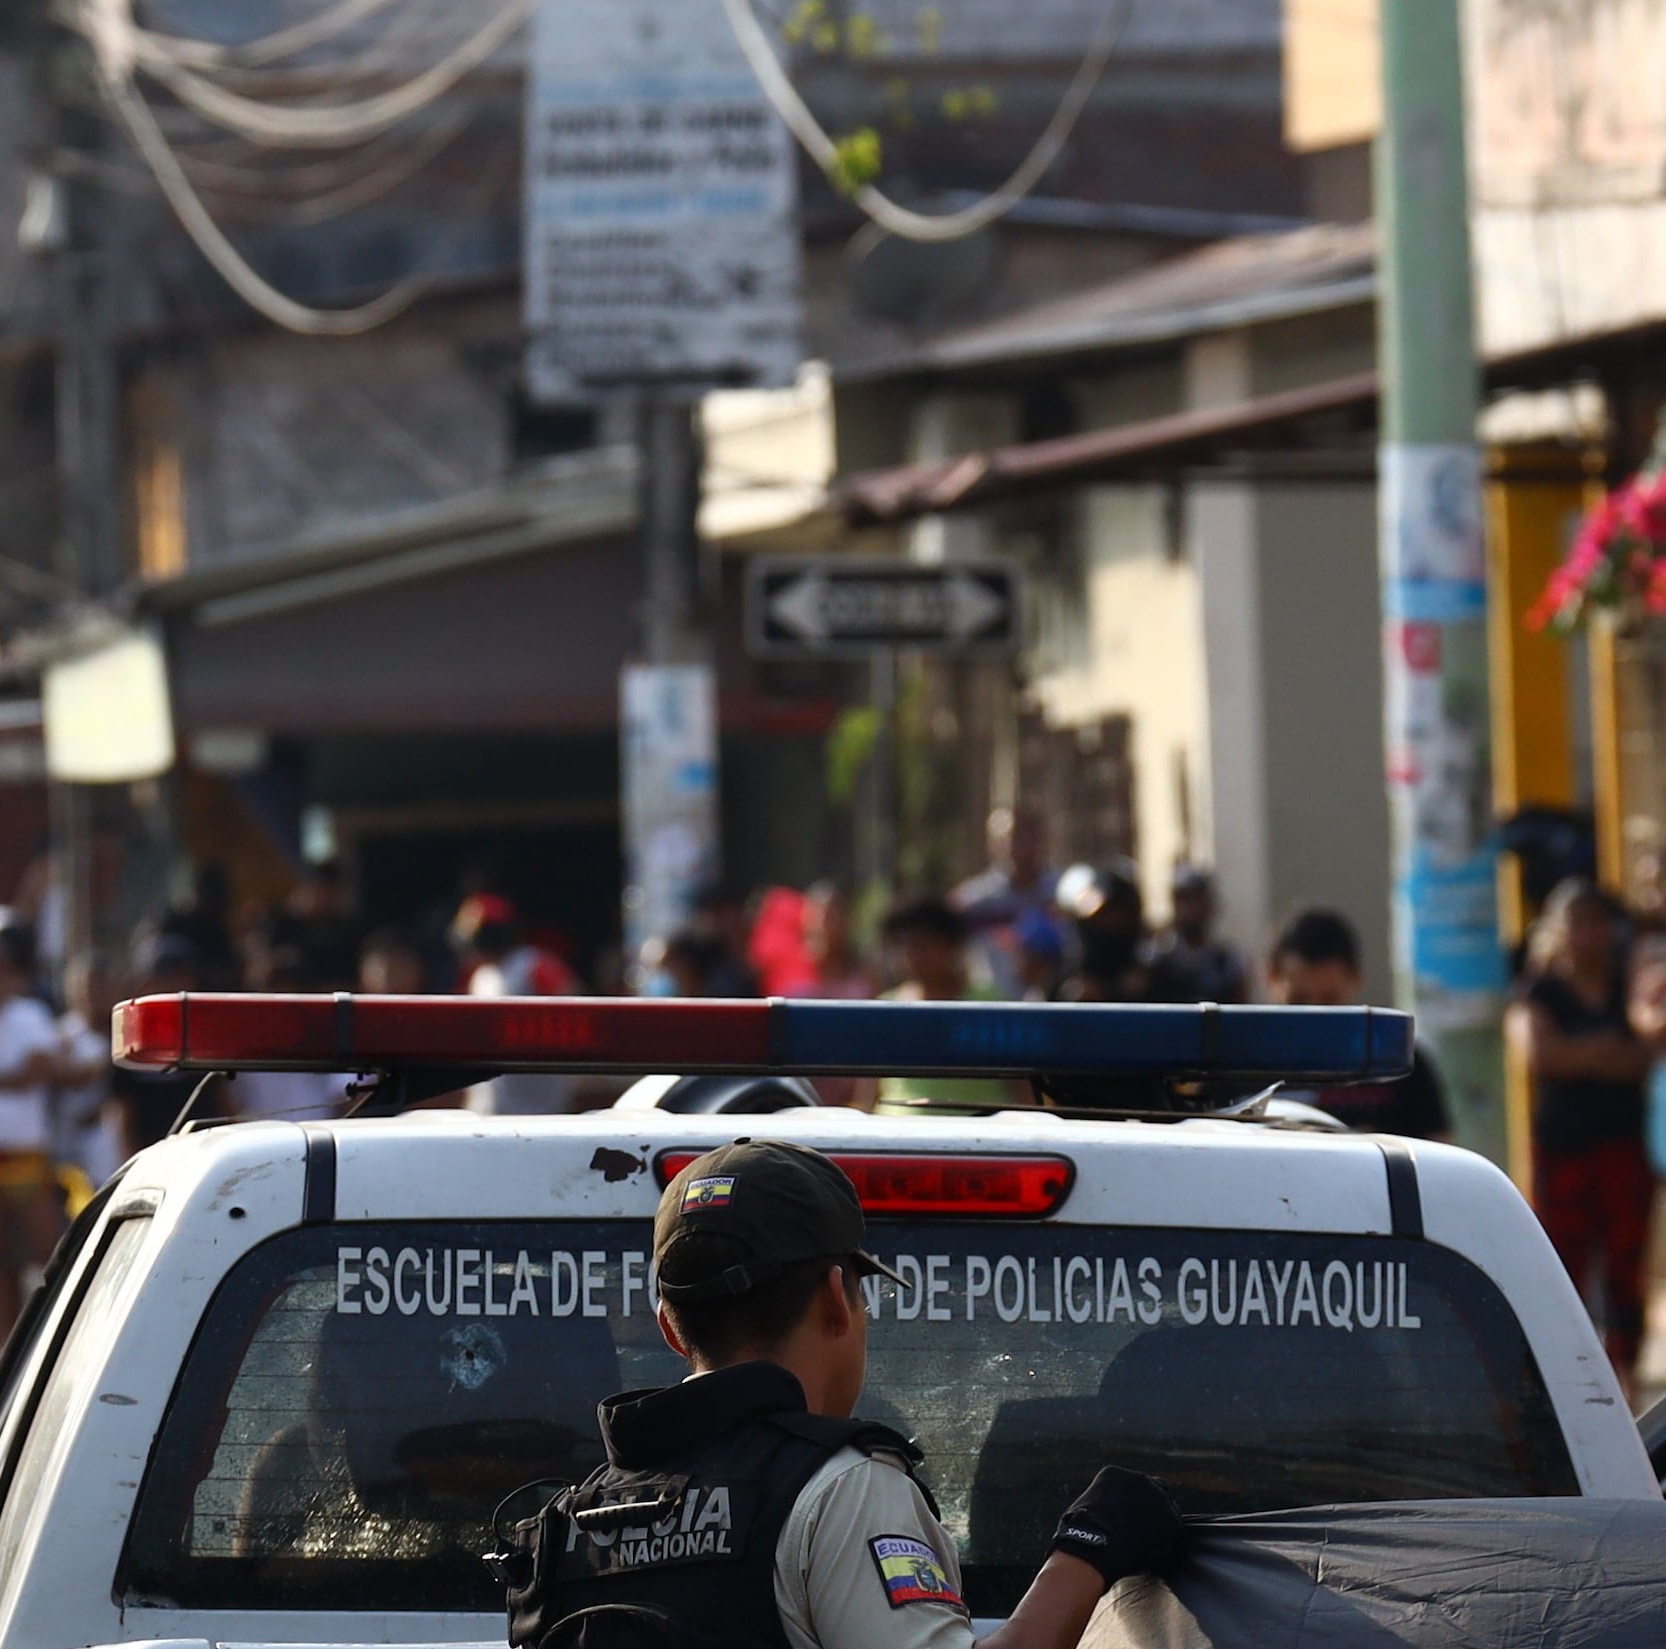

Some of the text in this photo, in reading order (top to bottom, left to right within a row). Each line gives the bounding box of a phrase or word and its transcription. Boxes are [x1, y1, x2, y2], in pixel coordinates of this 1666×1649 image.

[337, 1246, 539, 1317] ESCUELA
[551, 1250, 607, 1318] DE
[896, 1254, 951, 1321] DE
[966, 1254, 1163, 1325] POLICIAS
[1178, 1257, 1422, 1333] GUAYAQUIL
[619, 1530, 732, 1566] NACIONAL
[1066, 1528, 1101, 1543] SPORT
